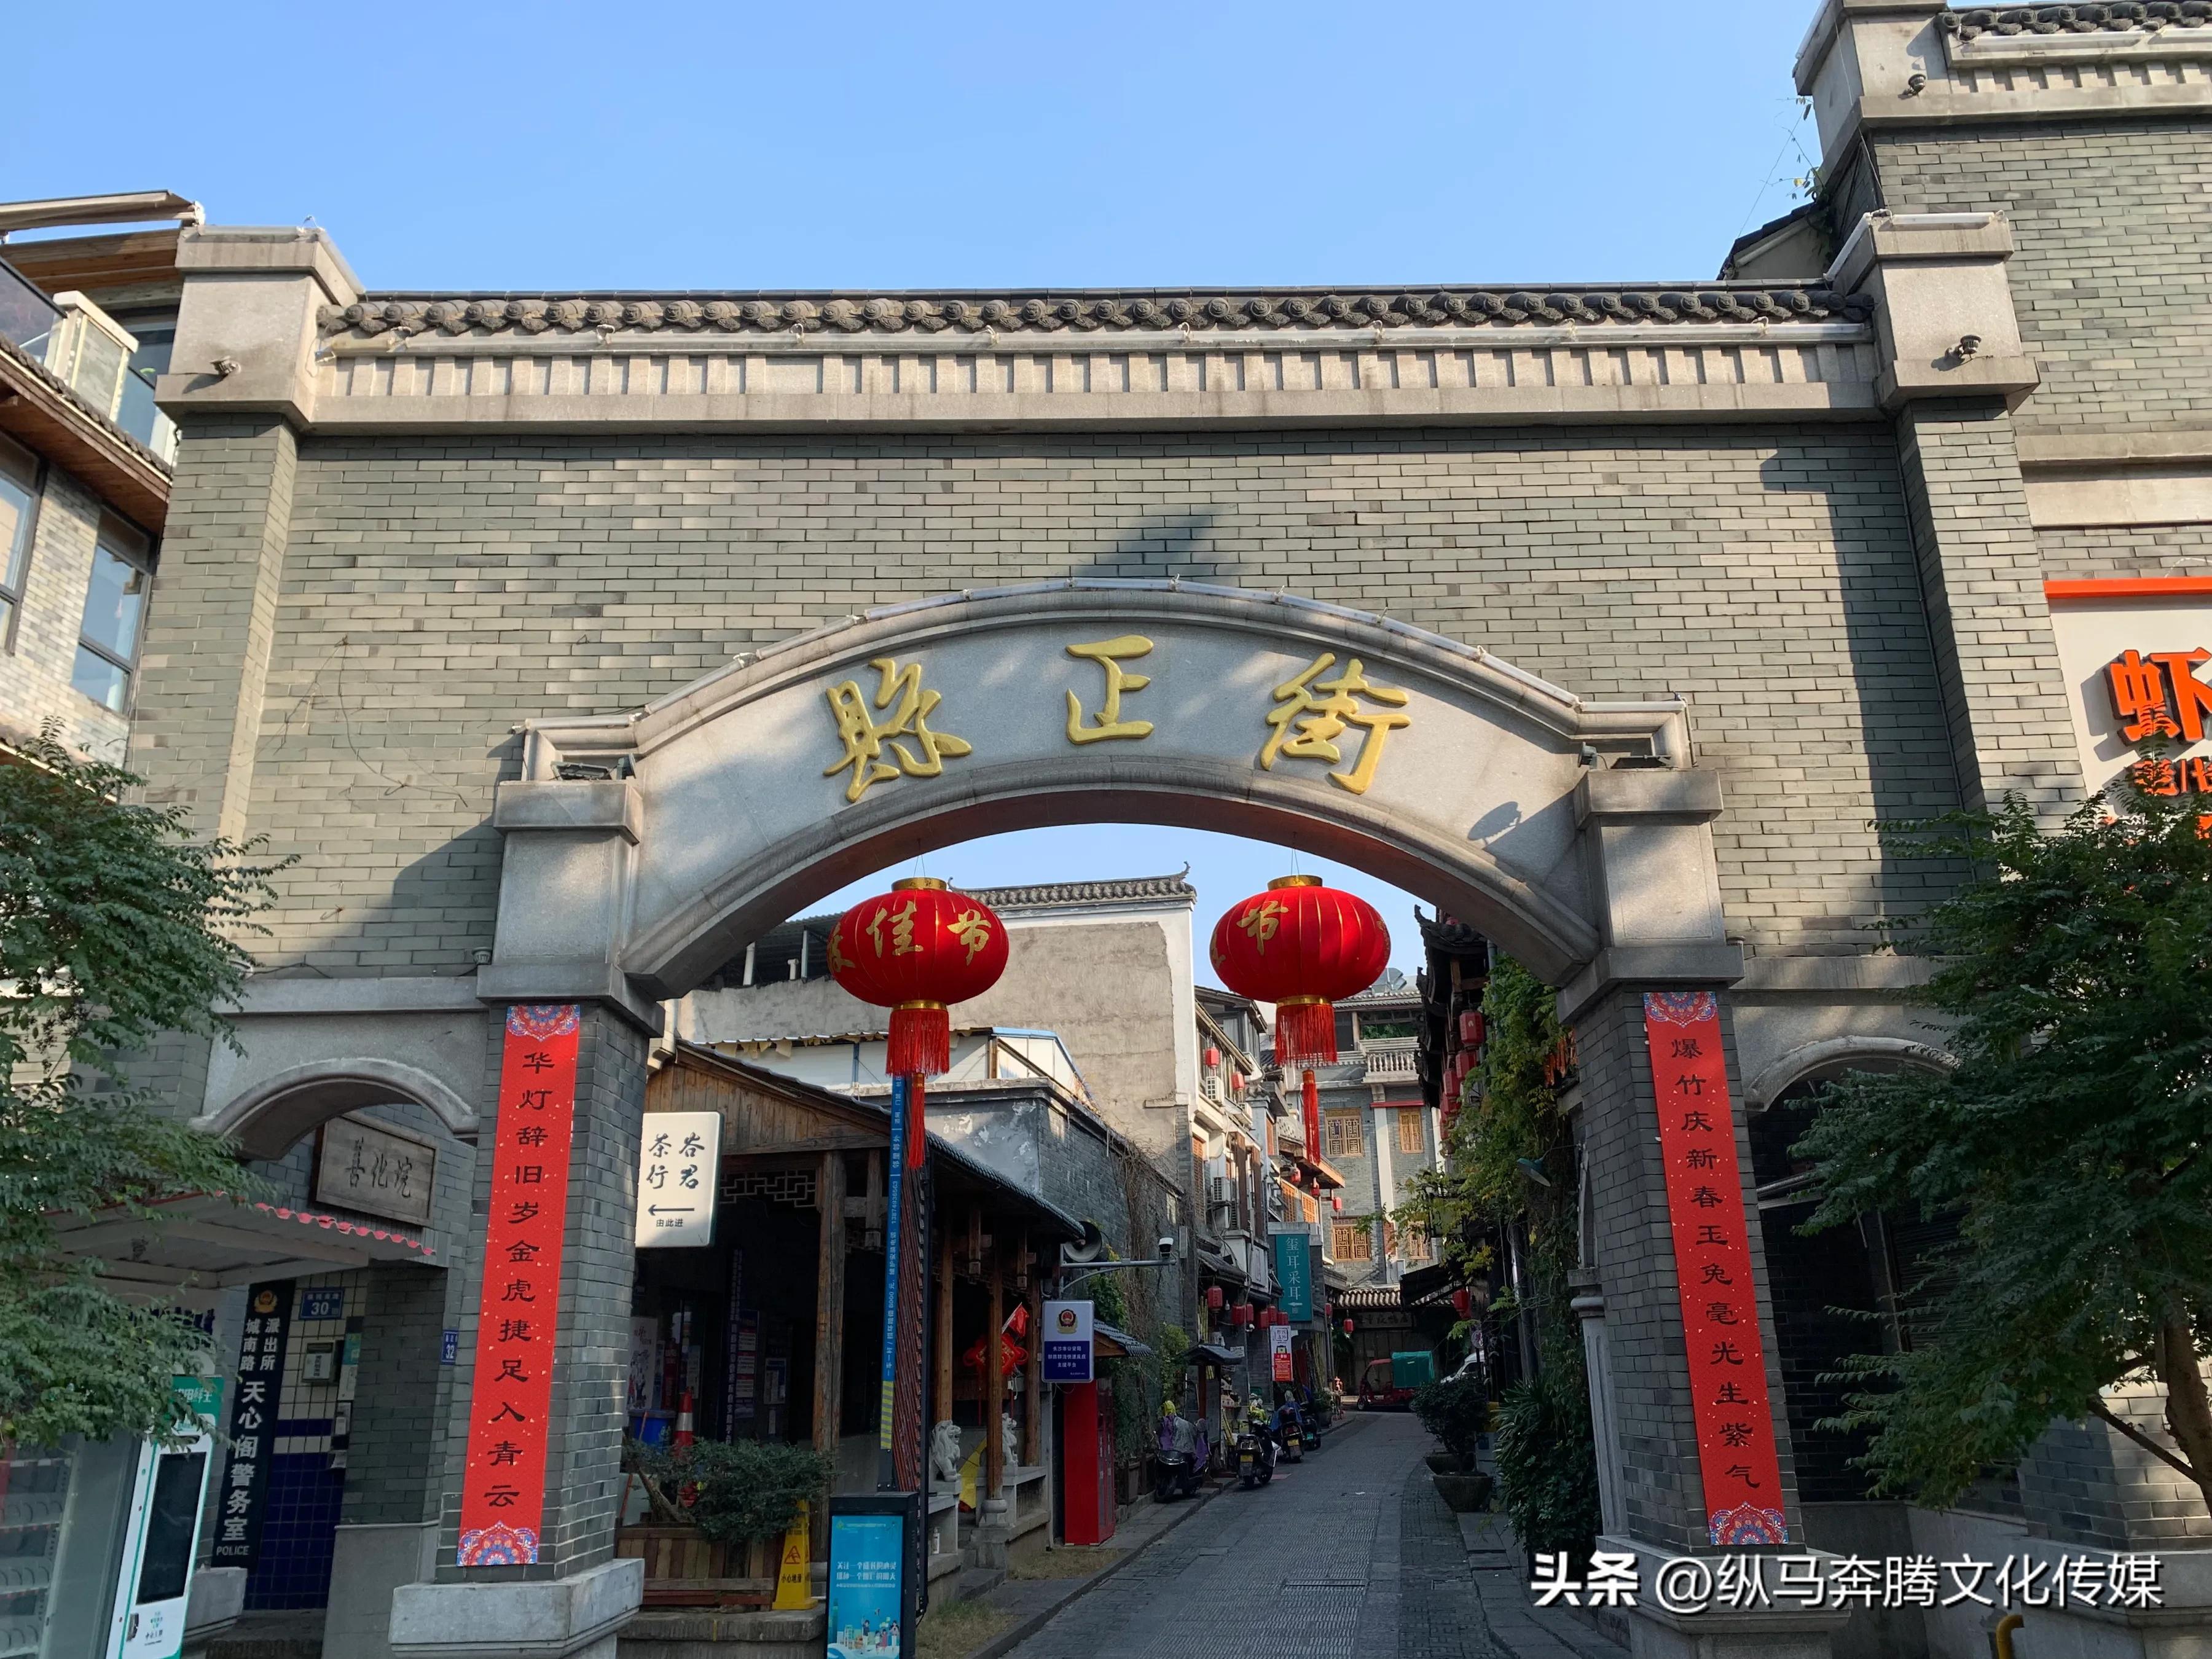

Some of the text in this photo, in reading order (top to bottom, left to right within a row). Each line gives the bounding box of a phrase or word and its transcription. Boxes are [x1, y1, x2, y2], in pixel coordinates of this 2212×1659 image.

[656, 1218, 683, 1227] 由此进
[484, 1051, 555, 1507] 华灯辞旧岁金虎捷足入青云
[1671, 1038, 1761, 1489] 爆竹庆新春玉兔毫光生紫气
[311, 1301, 329, 1316] 30
[239, 1318, 261, 1371] 城南路
[259, 1318, 280, 1371] 派出所
[221, 1381, 267, 1542] 天心阁警务室
[216, 1545, 249, 1556] POLICE
